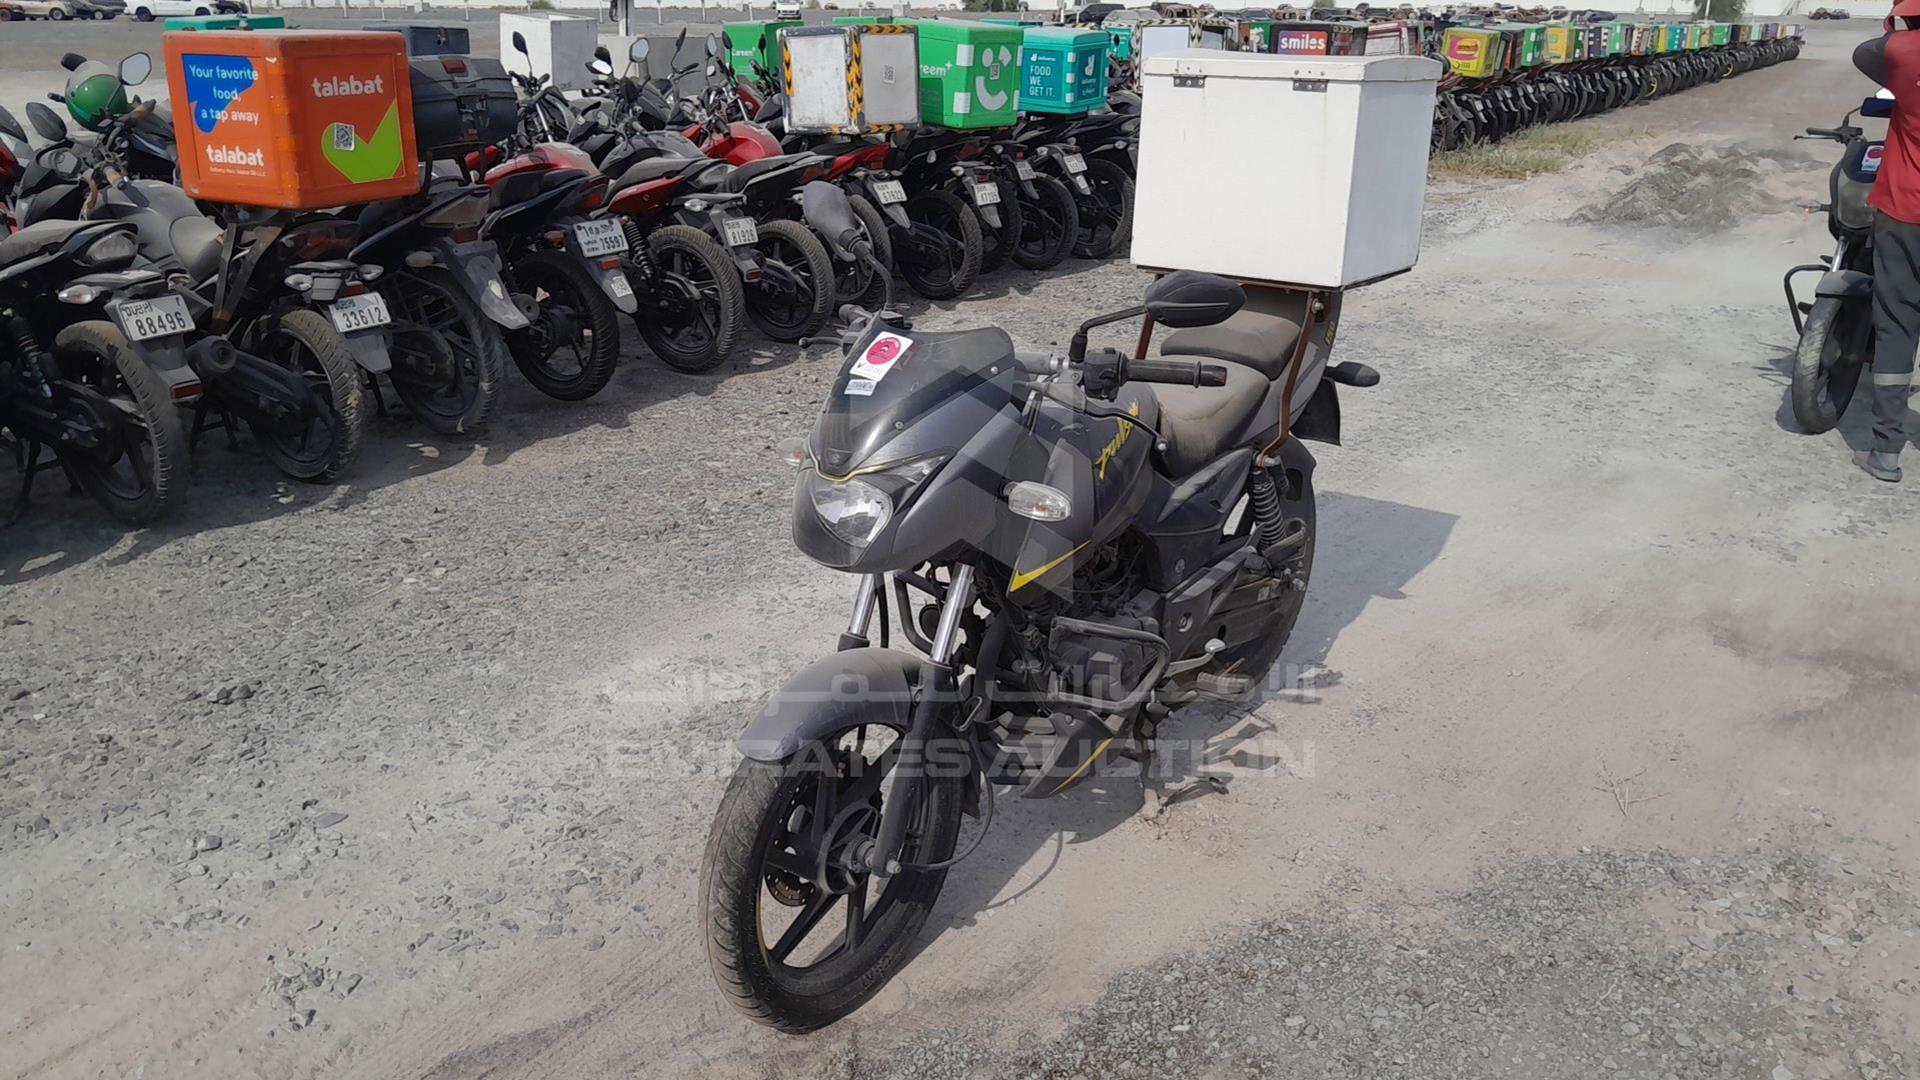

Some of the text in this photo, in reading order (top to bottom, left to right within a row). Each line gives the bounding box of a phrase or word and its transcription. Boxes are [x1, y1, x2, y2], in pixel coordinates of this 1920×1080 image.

[1280, 34, 1327, 51] smiles
[189, 64, 259, 81] Your favorite
[1029, 76, 1042, 86] WE
[212, 85, 242, 102] food,
[311, 74, 384, 98] talabat
[1029, 86, 1044, 96] GET
[201, 107, 259, 126] a tap away
[206, 143, 265, 168] talabat
[599, 234, 625, 251] 75597
[135, 311, 186, 337] 88496
[342, 306, 384, 329] 33612
